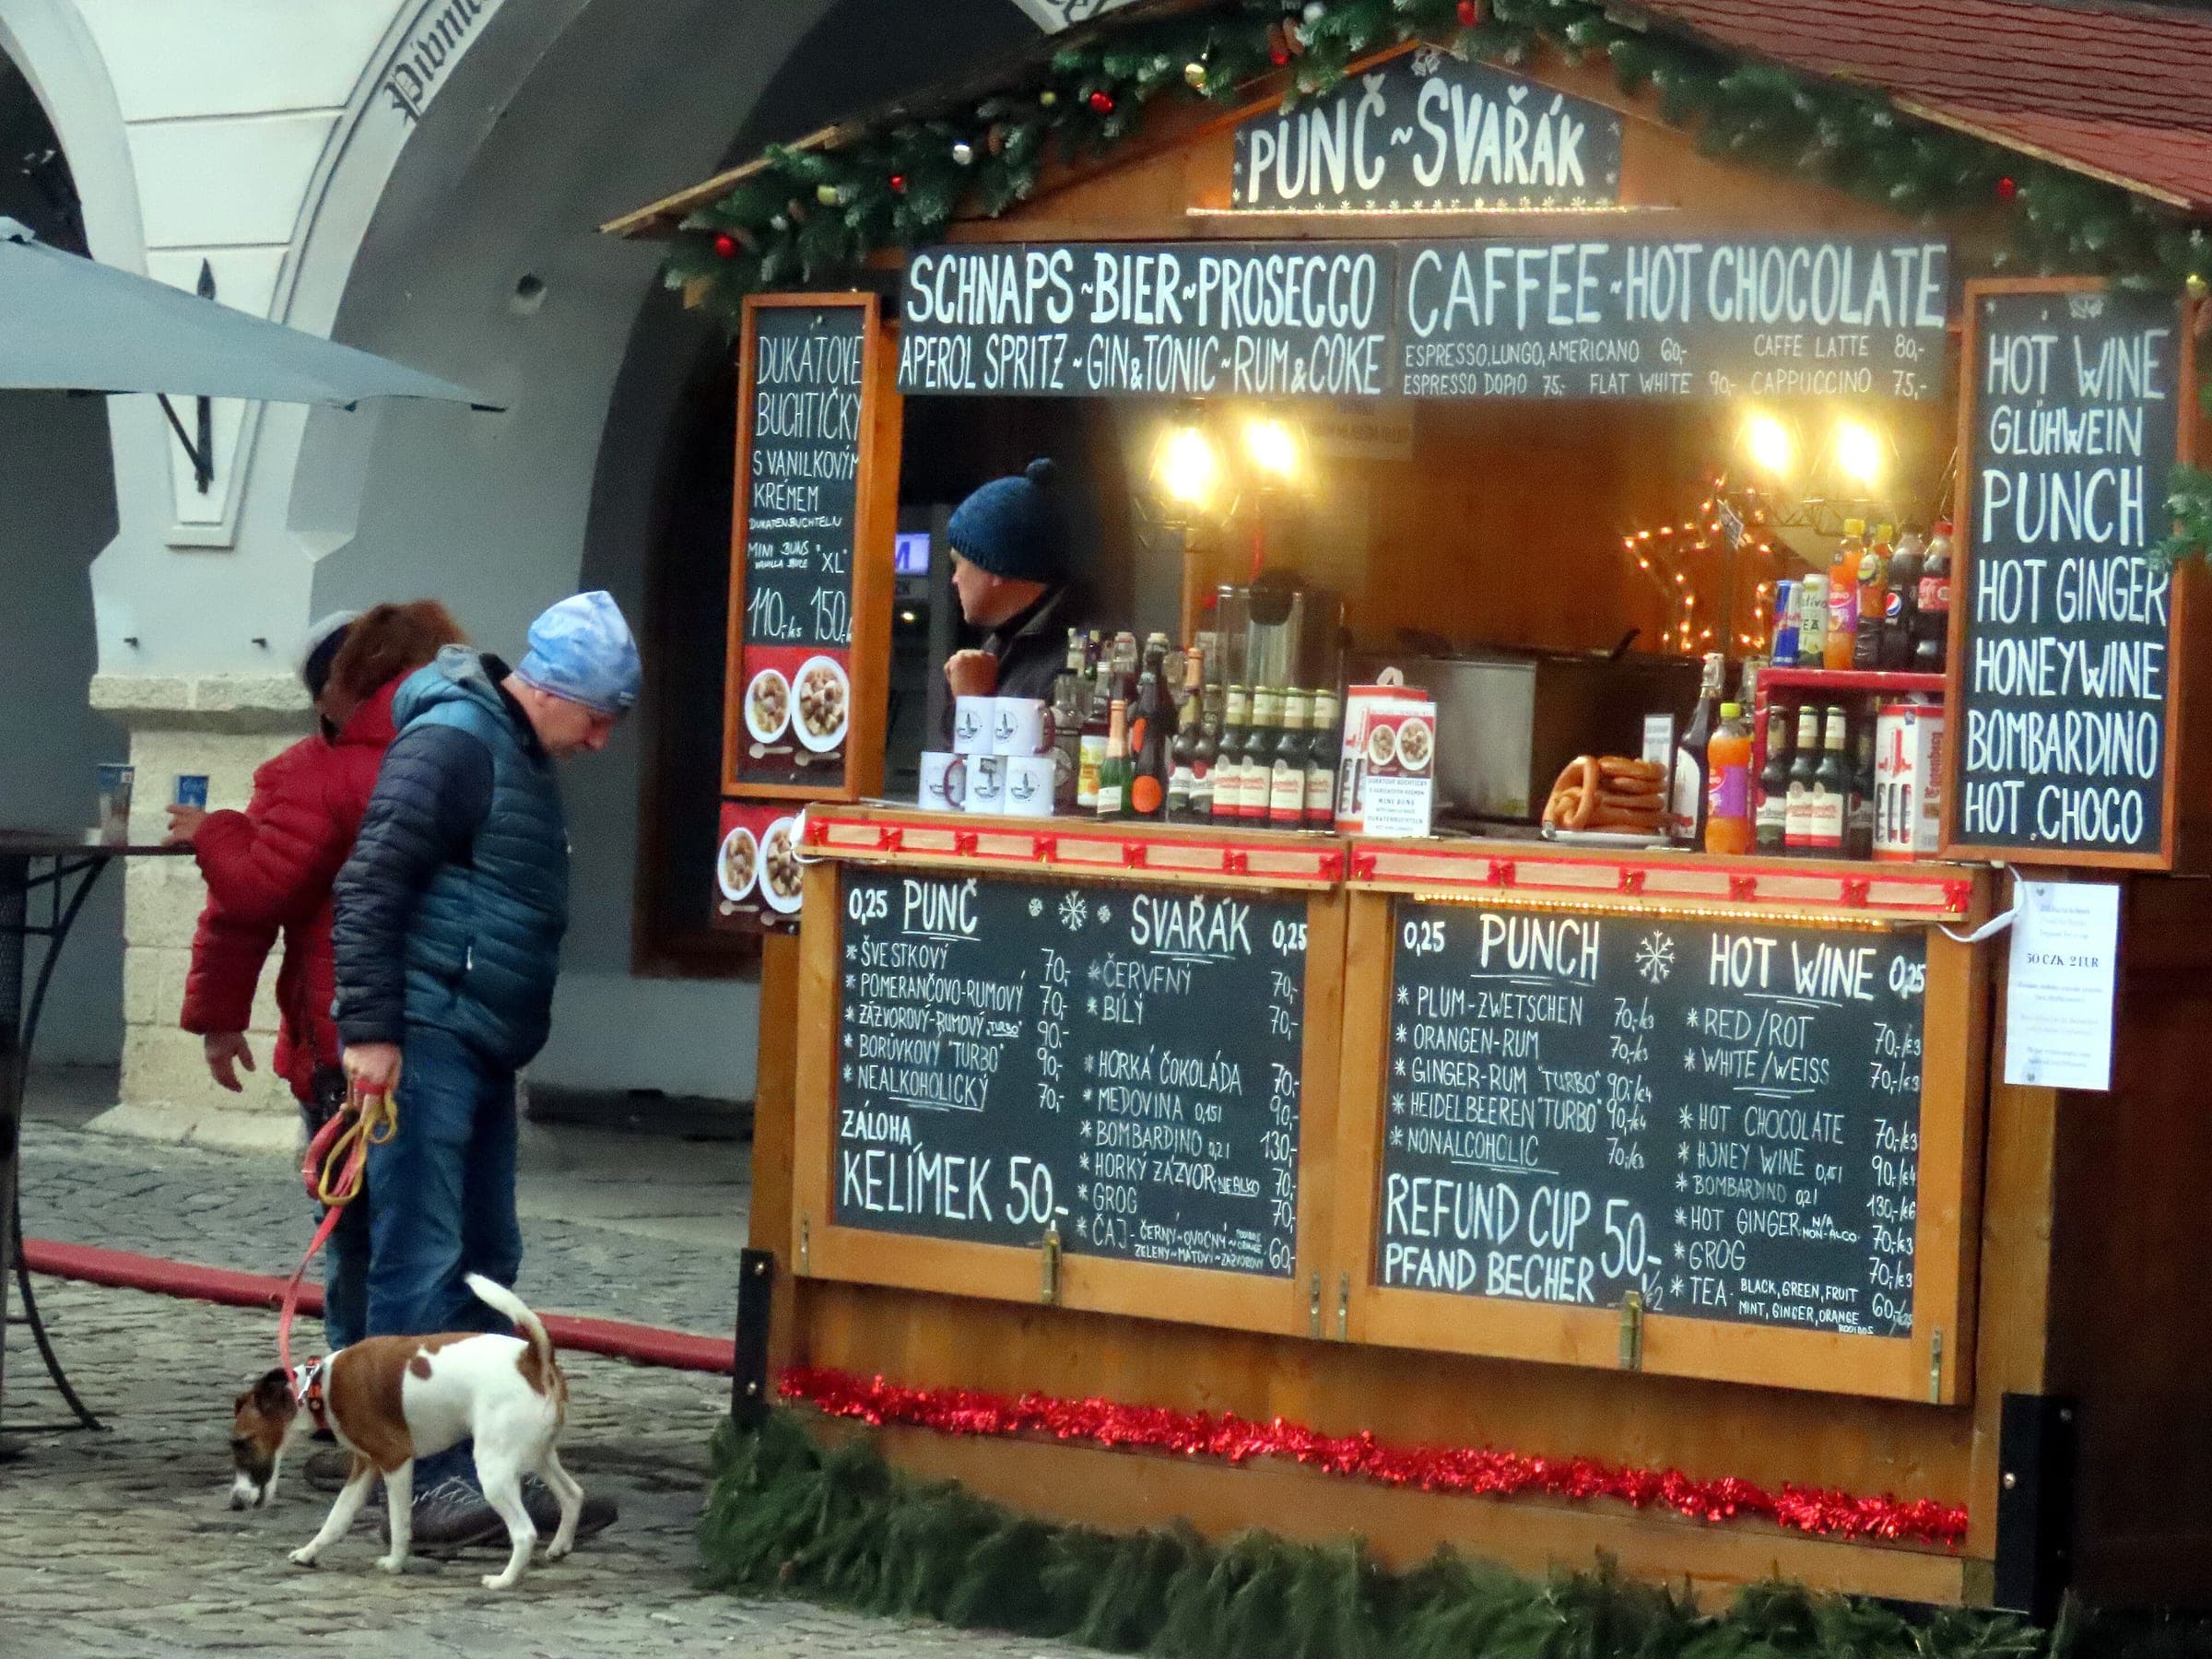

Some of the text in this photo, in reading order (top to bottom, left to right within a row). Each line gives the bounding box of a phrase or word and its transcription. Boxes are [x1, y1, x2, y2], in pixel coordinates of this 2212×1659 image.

[1248, 73, 1585, 203] PUNČ SVAŘÁK
[1407, 244, 1947, 337] CAFFEE HOT CHOCOLATE
[898, 335, 975, 389] APEROL
[983, 333, 1068, 389] SPRITZ
[1754, 335, 1802, 359] CAFFE
[1816, 335, 1870, 359] LATTE
[1987, 328, 2171, 401] HOT WINE
[1404, 373, 1477, 395] ESPRESSO
[1485, 375, 1527, 395] DOPIO
[1590, 373, 1630, 395] FLAT
[1639, 372, 1693, 395] WHITE
[1753, 369, 1872, 395] CAPPUCCINO
[1990, 399, 2144, 457] GLÜHWEIN
[753, 451, 762, 476] S
[1983, 465, 2144, 547] PUNCH
[747, 542, 773, 558] MINI
[821, 552, 845, 573] XL
[1977, 556, 2169, 627] HOT GINGER
[1966, 709, 2158, 780] BOMBARDINO
[1965, 781, 2144, 844] HOT CHOCO
[849, 878, 978, 934] 0,25 PUNČ
[1131, 894, 1308, 956] SVAŘÁK 0,25
[1404, 913, 1600, 980] 0,25 PUNCH
[1710, 933, 1777, 988] HOT
[1792, 940, 1877, 1000] WINE
[1101, 992, 1143, 1025] BÍLÝ
[858, 1065, 989, 1109] NEALKOHOLICKÝ
[1099, 1045, 1154, 1080] HORKÁ
[1159, 1050, 1242, 1096] ČOKOLÁDA
[841, 1100, 912, 1145] ZÁLOHA
[1098, 1087, 1183, 1121] MEDOVINA
[1411, 1093, 1535, 1129] HEIDELBEEREN
[1096, 1121, 1202, 1157] BOMBARDINO
[1700, 1103, 1731, 1132] HOT
[1745, 1106, 1844, 1144] CHOCOLATE
[1096, 1151, 1147, 1181] HORKÝ
[1408, 1128, 1538, 1166] NONALCOHOLIC
[1698, 1141, 1750, 1171] HONEY
[1760, 1146, 1804, 1176] WINE
[843, 1142, 993, 1221] KELÍMEK
[1093, 1182, 1137, 1214] GROG
[1693, 1175, 1786, 1203] BOMBARDINO
[1092, 1213, 1127, 1249] ČAJ
[1386, 1173, 1519, 1244] REFUND
[1529, 1185, 1591, 1252] CUP
[1690, 1206, 1725, 1232] HOT
[1737, 1207, 1799, 1238] GINGER
[1385, 1242, 1594, 1302] PFAND BECHER
[1689, 1240, 1746, 1271] GROG
[1690, 1277, 1727, 1307] TEA
[1826, 1286, 1858, 1302] FRUIT
[1819, 1311, 1859, 1324] ORANGE
